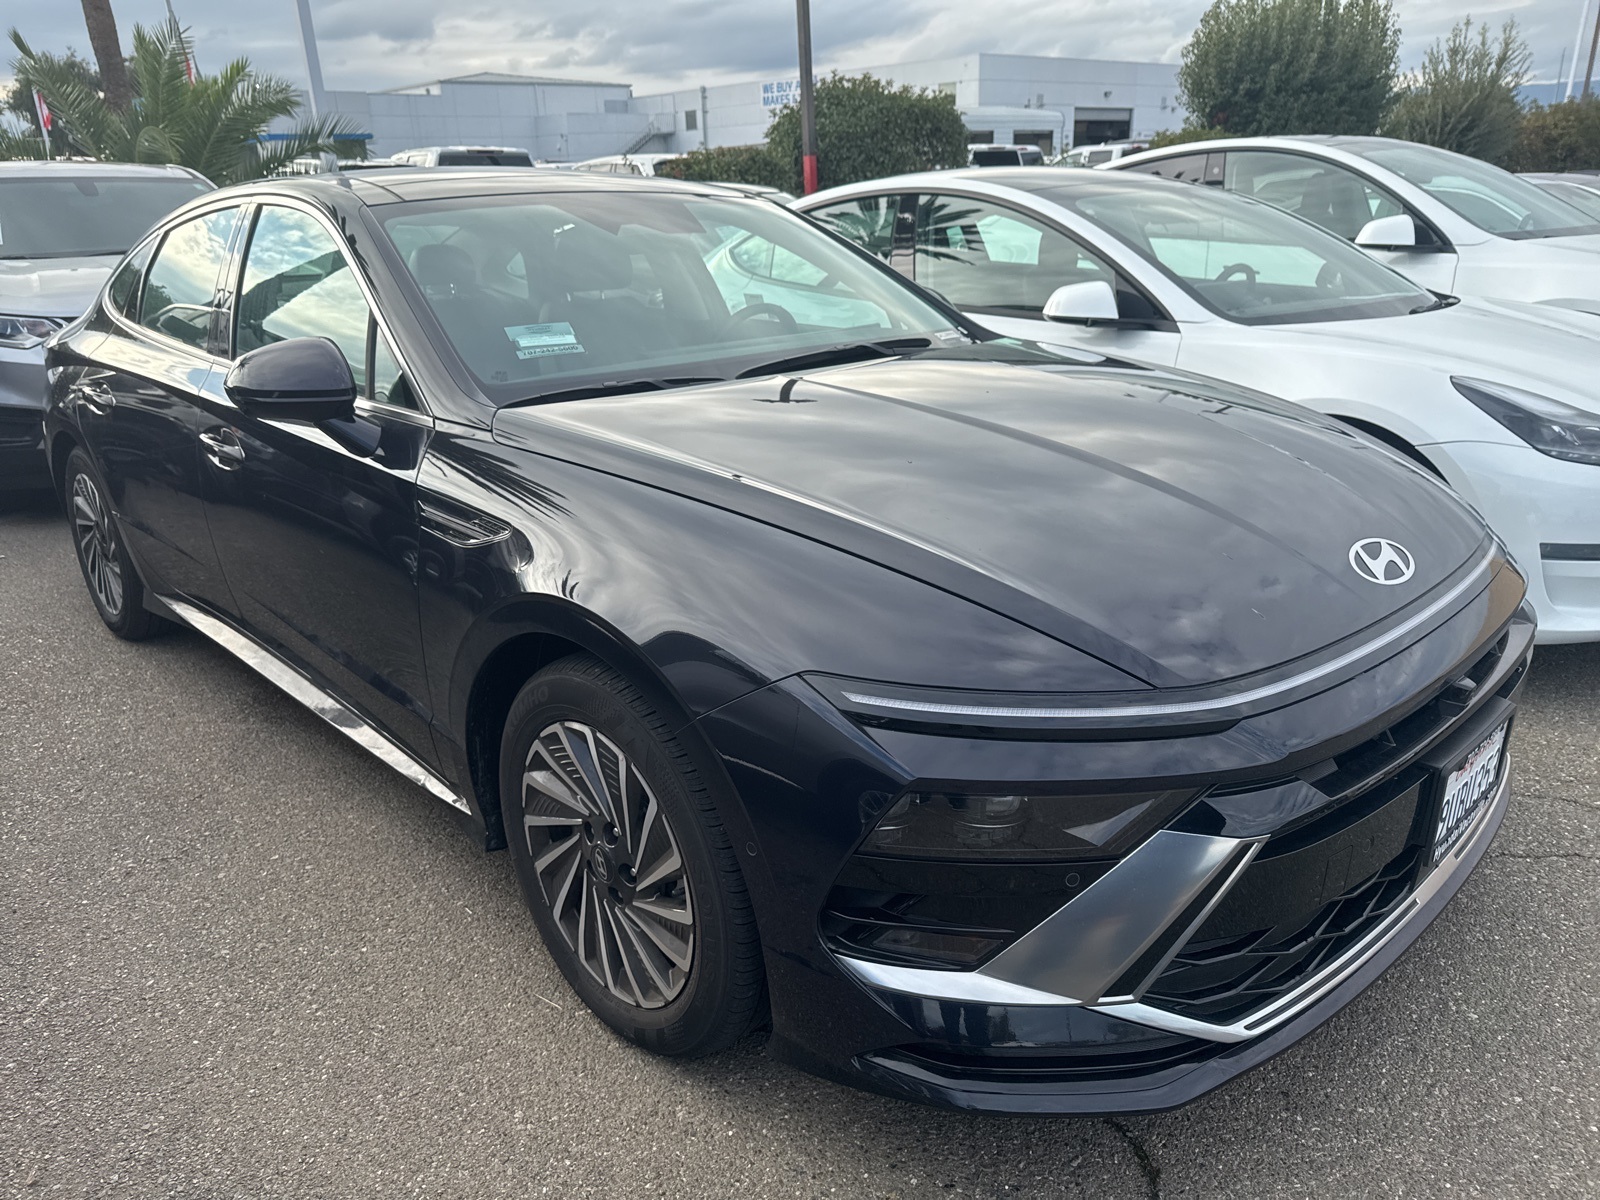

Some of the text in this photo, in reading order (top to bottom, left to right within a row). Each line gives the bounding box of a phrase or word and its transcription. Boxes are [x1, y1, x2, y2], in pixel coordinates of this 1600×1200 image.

[763, 83, 775, 94] WE
[776, 81, 794, 93] BUY
[763, 94, 790, 106] MAKES
